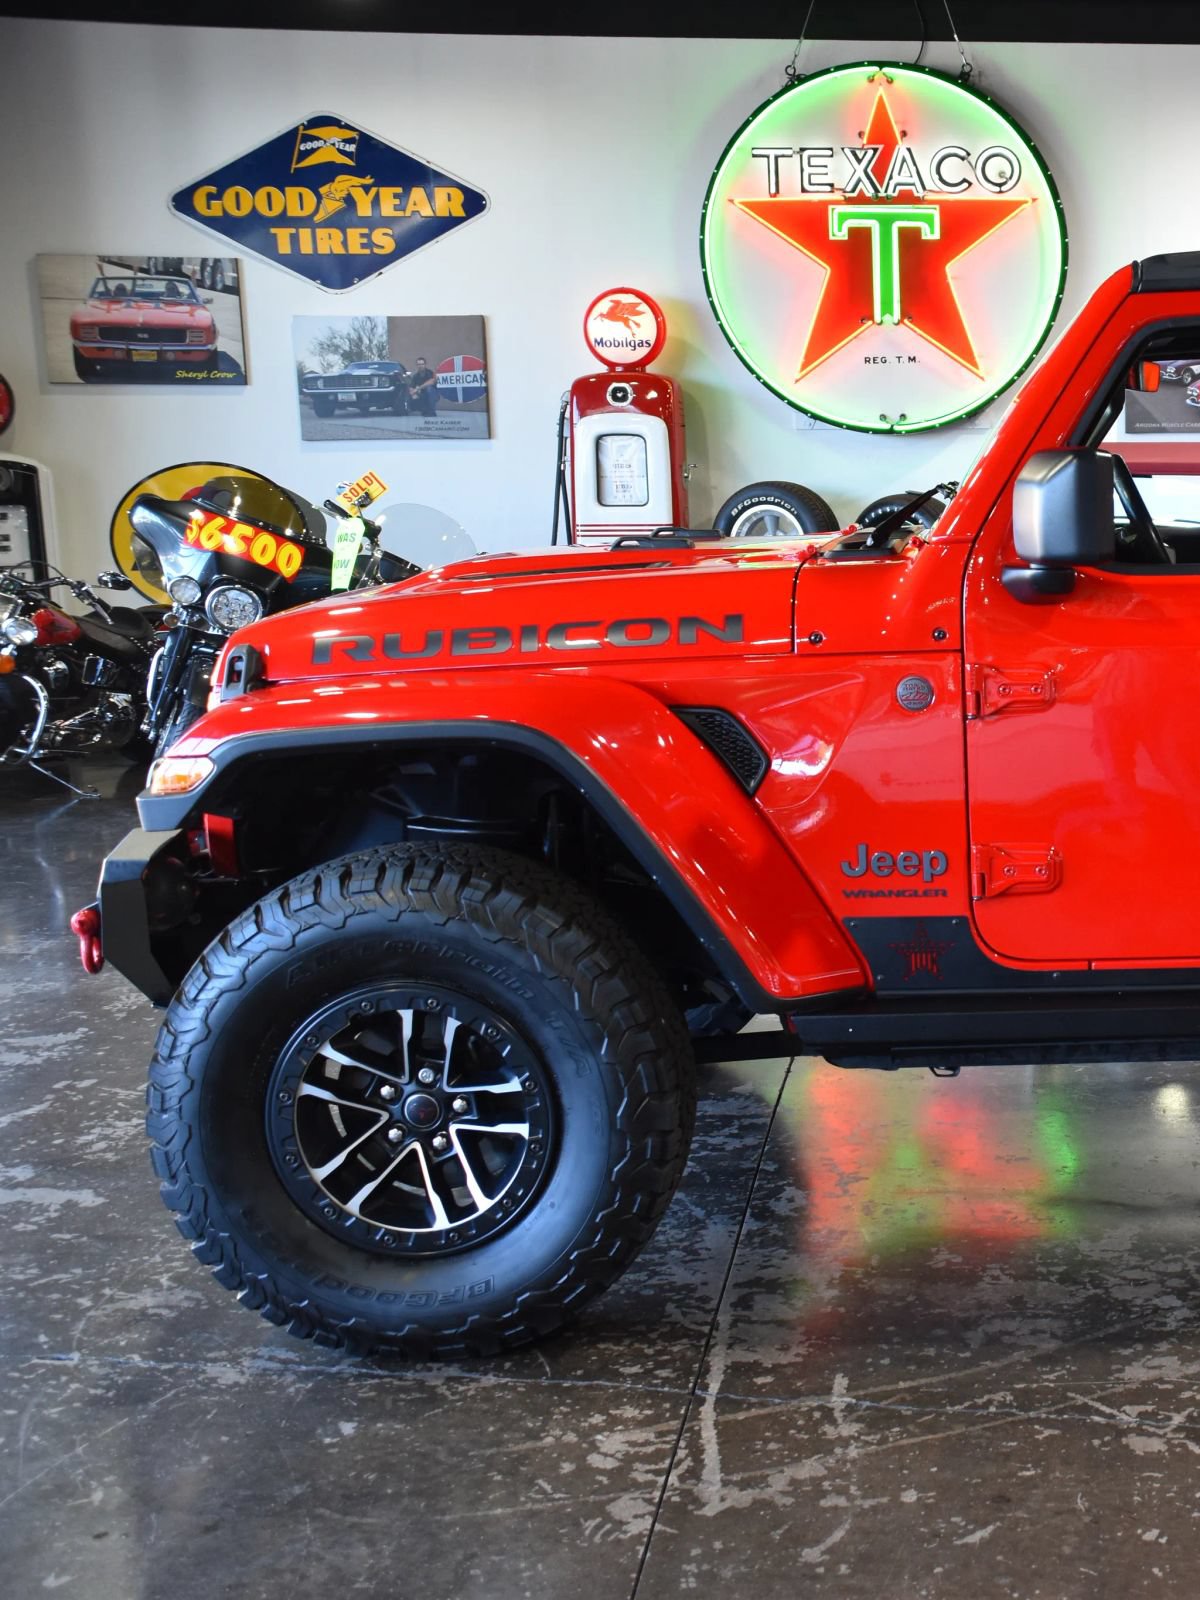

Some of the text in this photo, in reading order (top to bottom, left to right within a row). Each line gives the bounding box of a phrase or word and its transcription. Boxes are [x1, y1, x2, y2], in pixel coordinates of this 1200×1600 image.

[752, 146, 1021, 197] TEXACO
[269, 226, 397, 256] TIRES
[828, 204, 941, 326] T
[593, 336, 652, 352] Mobilgas
[864, 356, 892, 365] REG.
[342, 474, 375, 503] SOLD
[730, 495, 799, 517] BFGoodrich
[186, 512, 303, 579] $6500
[310, 613, 745, 666] RUBICON
[840, 842, 949, 883] Jeep
[842, 888, 949, 899] WRANGLER
